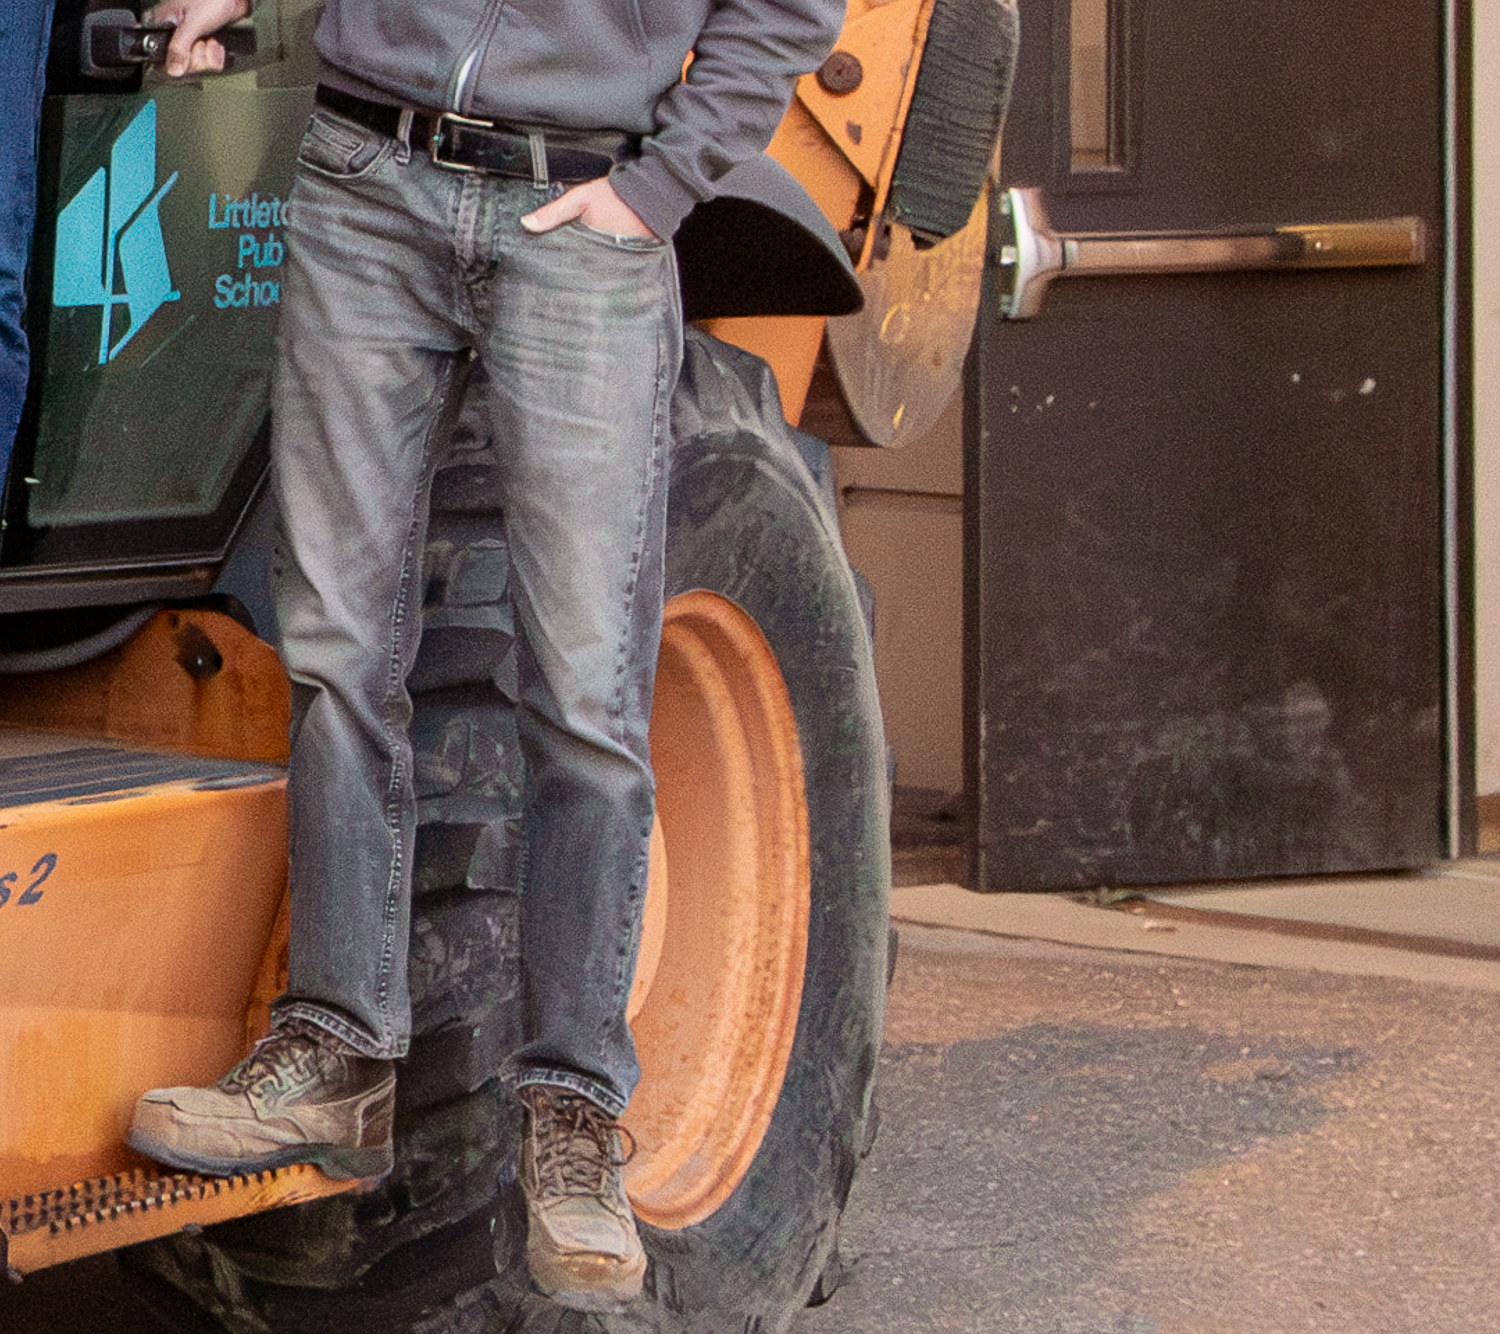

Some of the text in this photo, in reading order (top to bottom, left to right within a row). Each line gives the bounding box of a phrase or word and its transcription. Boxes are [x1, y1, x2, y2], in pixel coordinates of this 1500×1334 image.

[238, 232, 284, 268] Pub
[213, 272, 280, 309] Scho
[16, 852, 59, 907] 2
